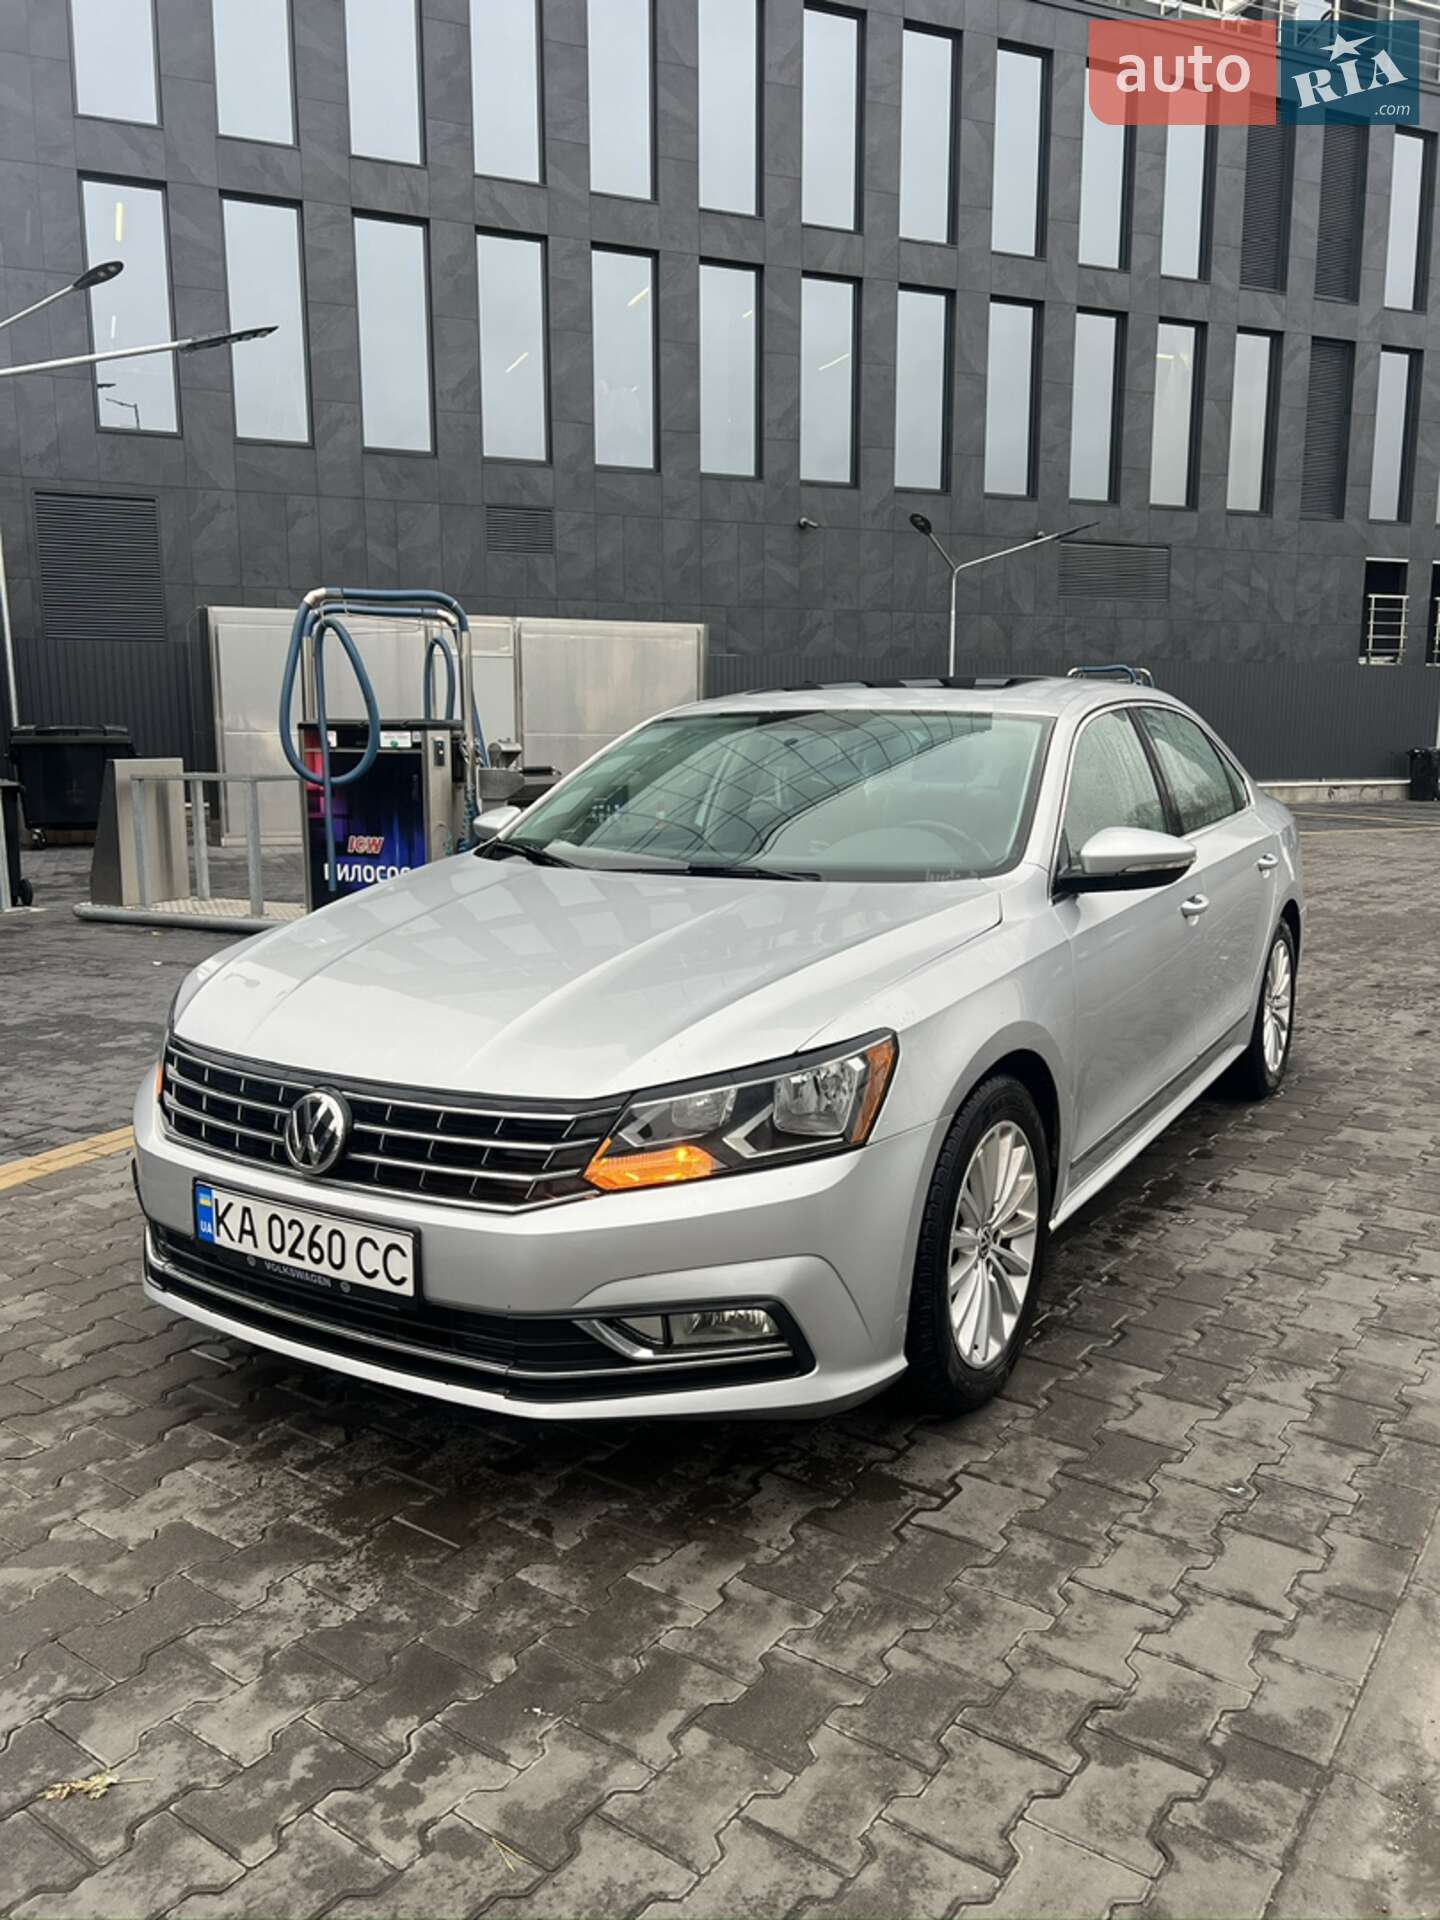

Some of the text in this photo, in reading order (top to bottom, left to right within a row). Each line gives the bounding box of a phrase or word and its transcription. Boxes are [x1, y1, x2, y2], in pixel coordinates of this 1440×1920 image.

[200, 1221, 213, 1234] UA
[214, 1198, 408, 1287] KA 0260 CC
